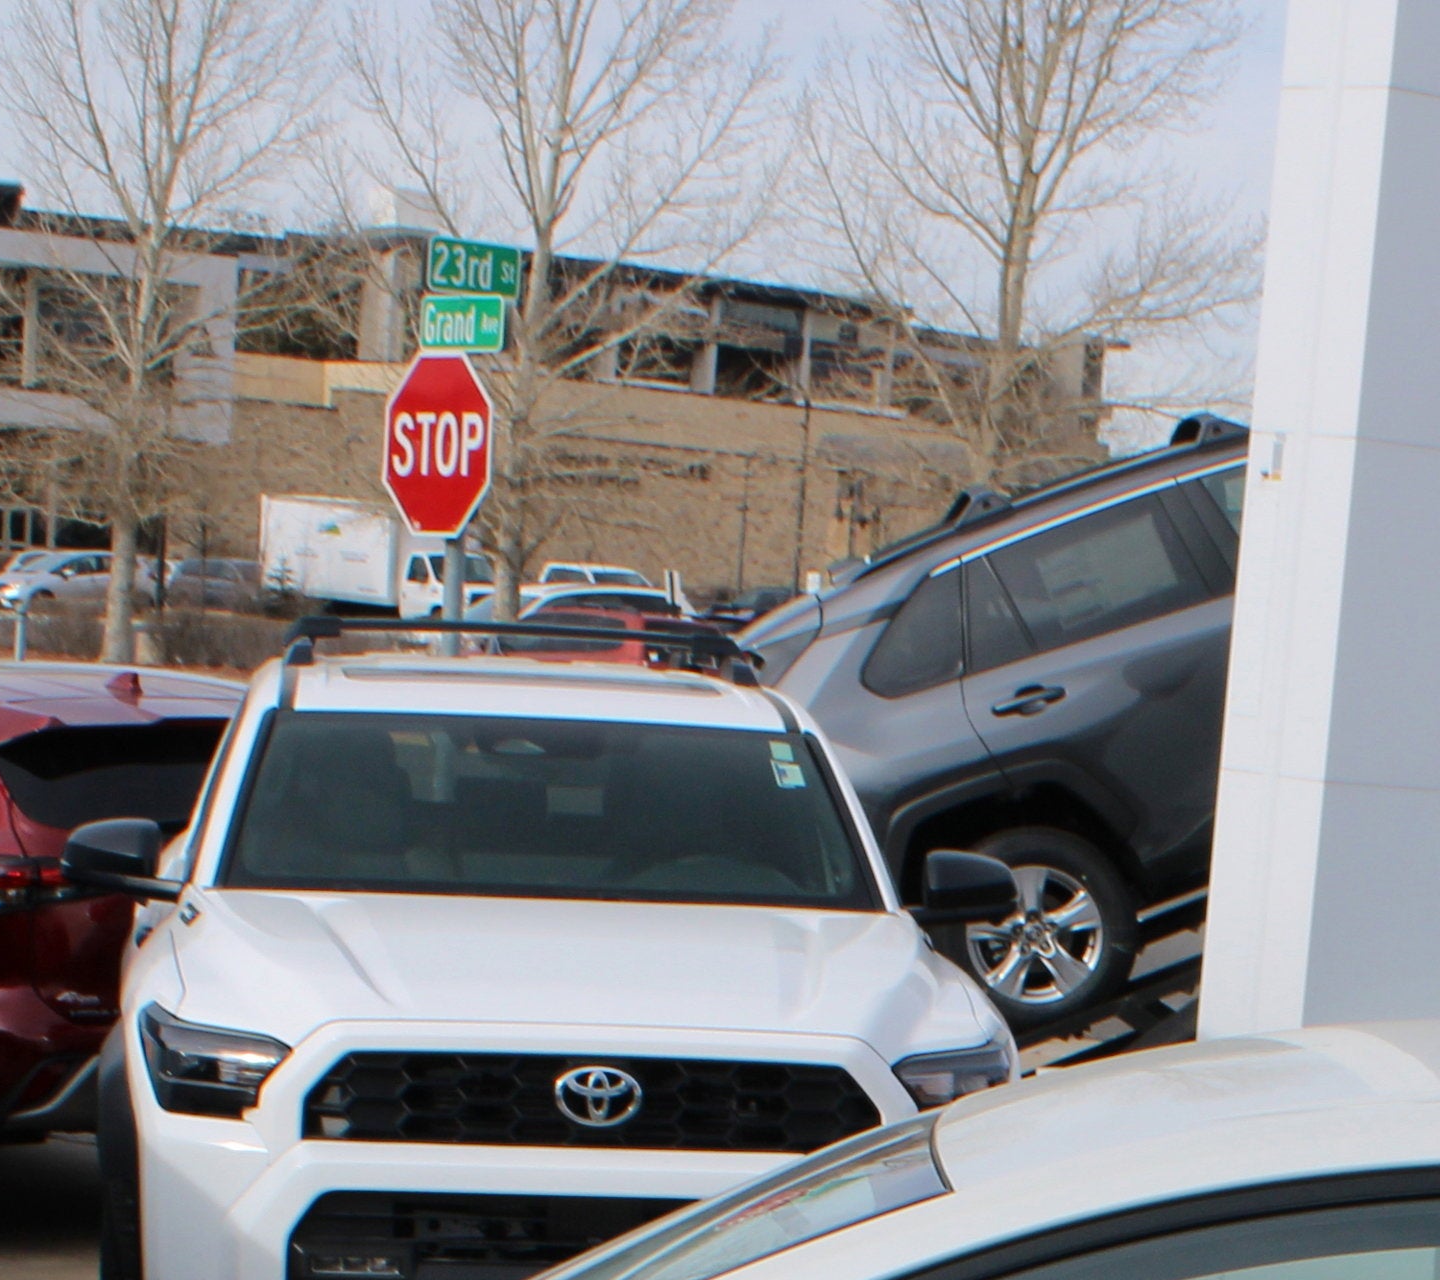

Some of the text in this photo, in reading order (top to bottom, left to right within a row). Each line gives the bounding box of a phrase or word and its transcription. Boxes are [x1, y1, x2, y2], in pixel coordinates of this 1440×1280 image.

[432, 241, 494, 291] 23rd
[424, 302, 477, 345] Grand
[392, 411, 485, 478] STOP
